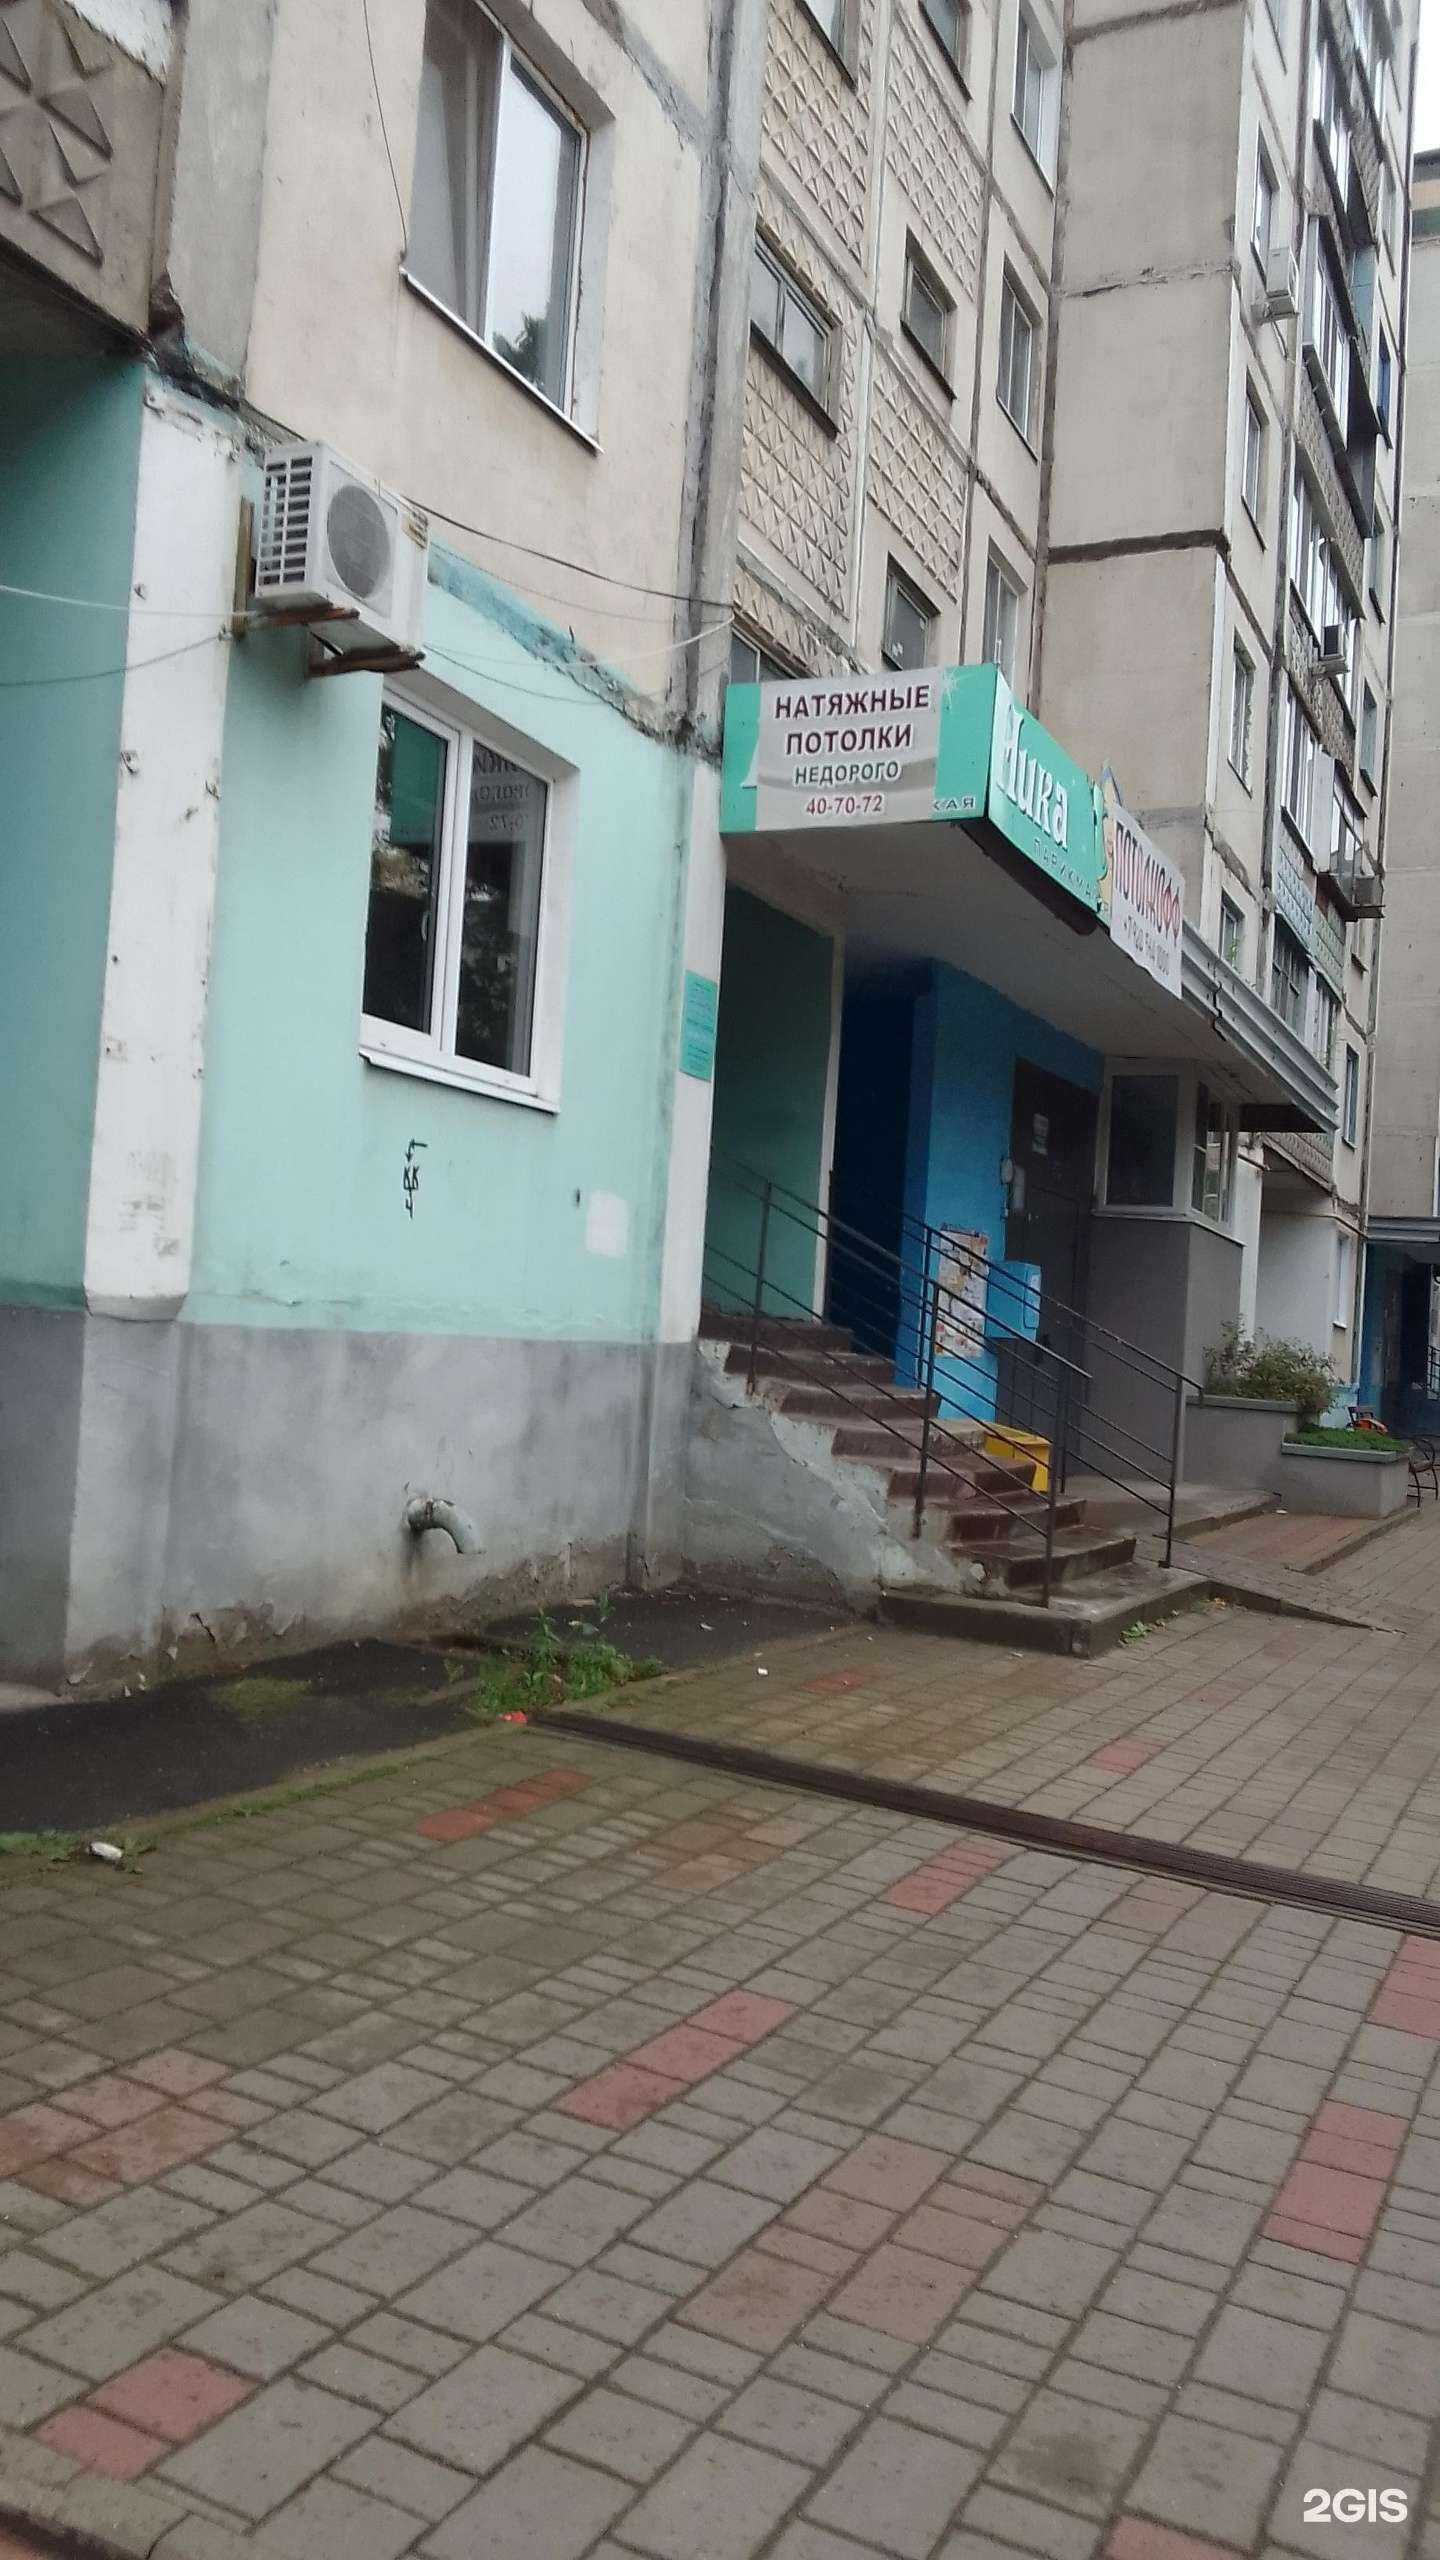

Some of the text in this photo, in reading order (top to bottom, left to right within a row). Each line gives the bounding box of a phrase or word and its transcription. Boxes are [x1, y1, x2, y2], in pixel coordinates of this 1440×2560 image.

[775, 685, 930, 719] НАТЯЖНЫЕ
[786, 724, 912, 755] ПОТОЛКИ
[795, 761, 899, 786] НЕДОРОГО
[806, 795, 883, 816] 40-70-72
